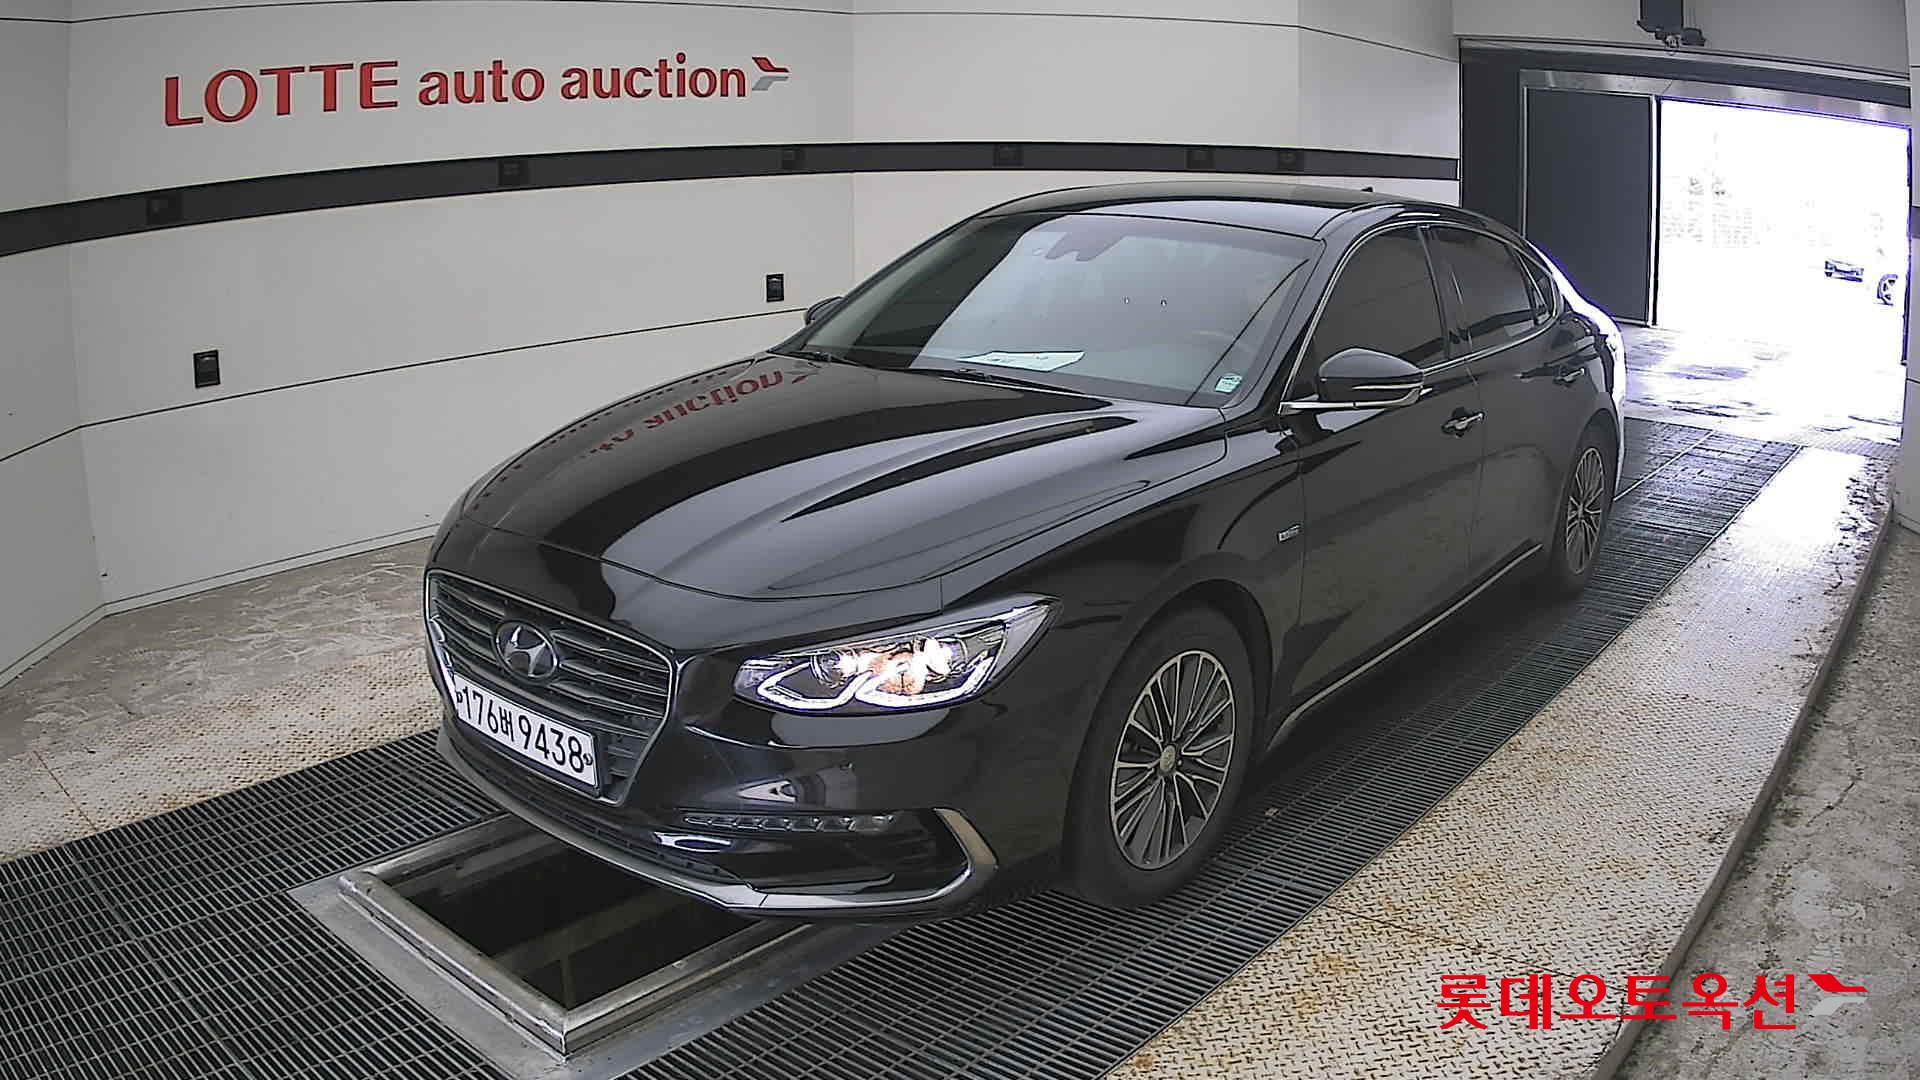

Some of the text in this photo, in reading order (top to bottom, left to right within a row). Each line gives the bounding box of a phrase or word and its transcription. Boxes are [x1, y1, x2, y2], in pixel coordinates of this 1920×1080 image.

[164, 52, 747, 127] LOTTE auto auction
[462, 685, 584, 774] 176버 9438
